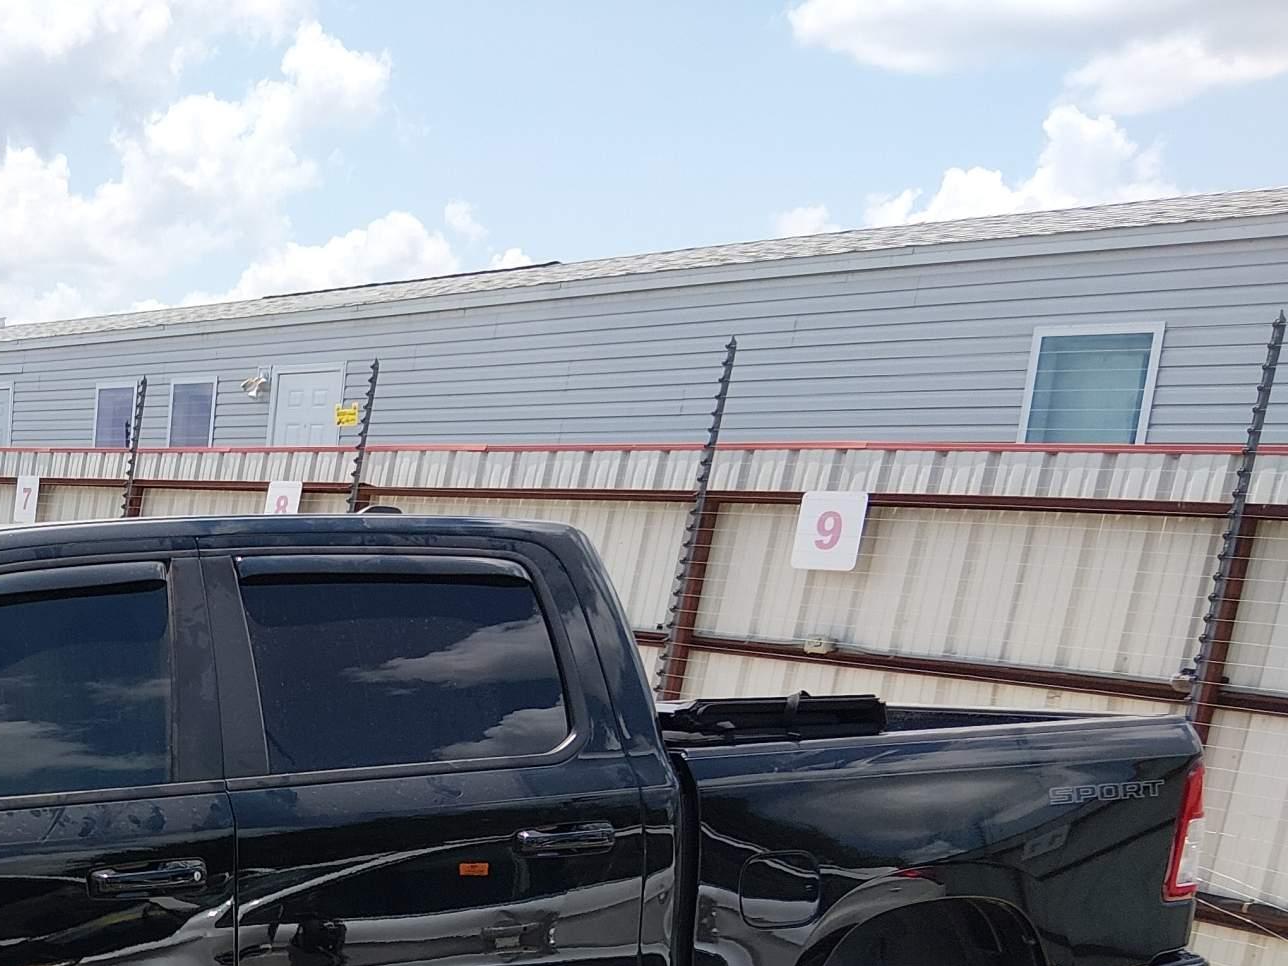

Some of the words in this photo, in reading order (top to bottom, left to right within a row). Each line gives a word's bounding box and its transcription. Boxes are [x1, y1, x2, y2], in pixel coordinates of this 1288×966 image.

[22, 487, 32, 510] 7
[275, 495, 289, 514] 8
[813, 510, 843, 551] 9
[1048, 779, 1166, 805] SPORT
